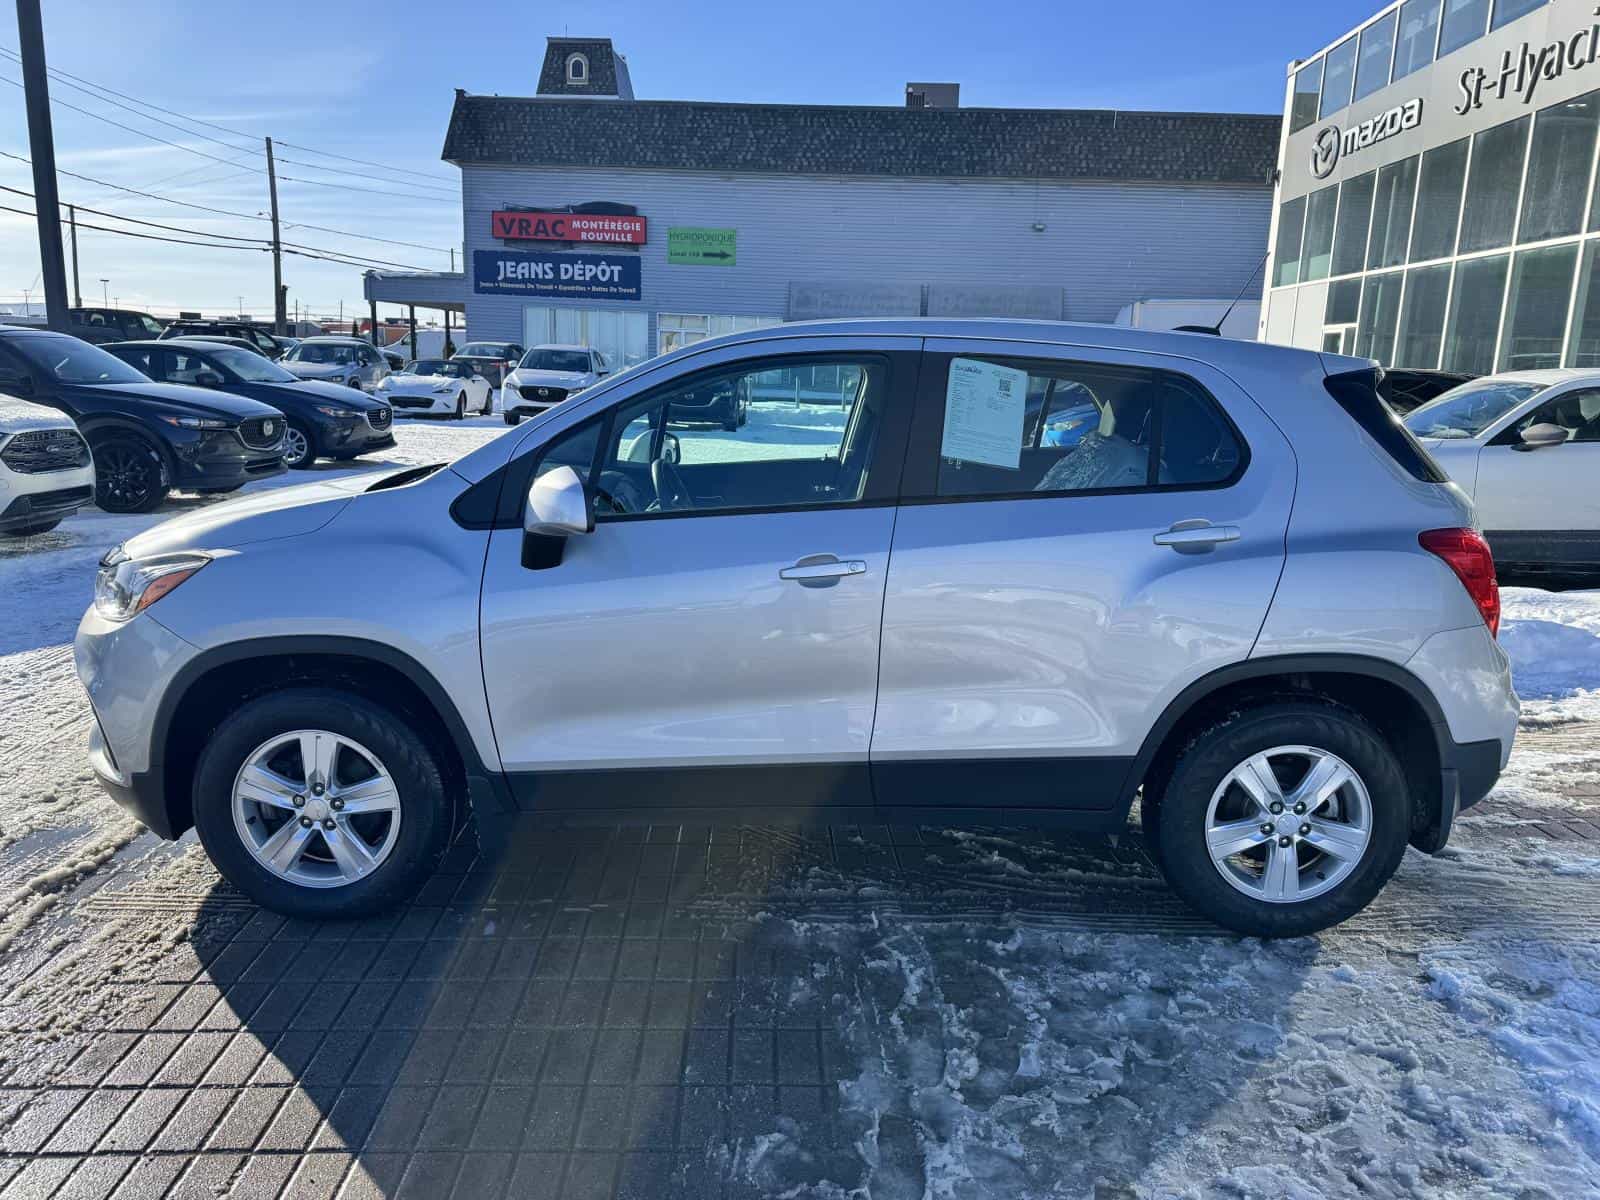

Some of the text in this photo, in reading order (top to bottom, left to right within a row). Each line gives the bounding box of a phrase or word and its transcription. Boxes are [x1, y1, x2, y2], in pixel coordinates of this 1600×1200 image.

[1341, 6, 1600, 157] mazda St-Hyaci
[499, 217, 566, 238] VRAC
[572, 219, 641, 231] MONTÉRÉGIE
[580, 232, 633, 242] ROUVILLE
[497, 260, 623, 282] JEANS DÉPÔT
